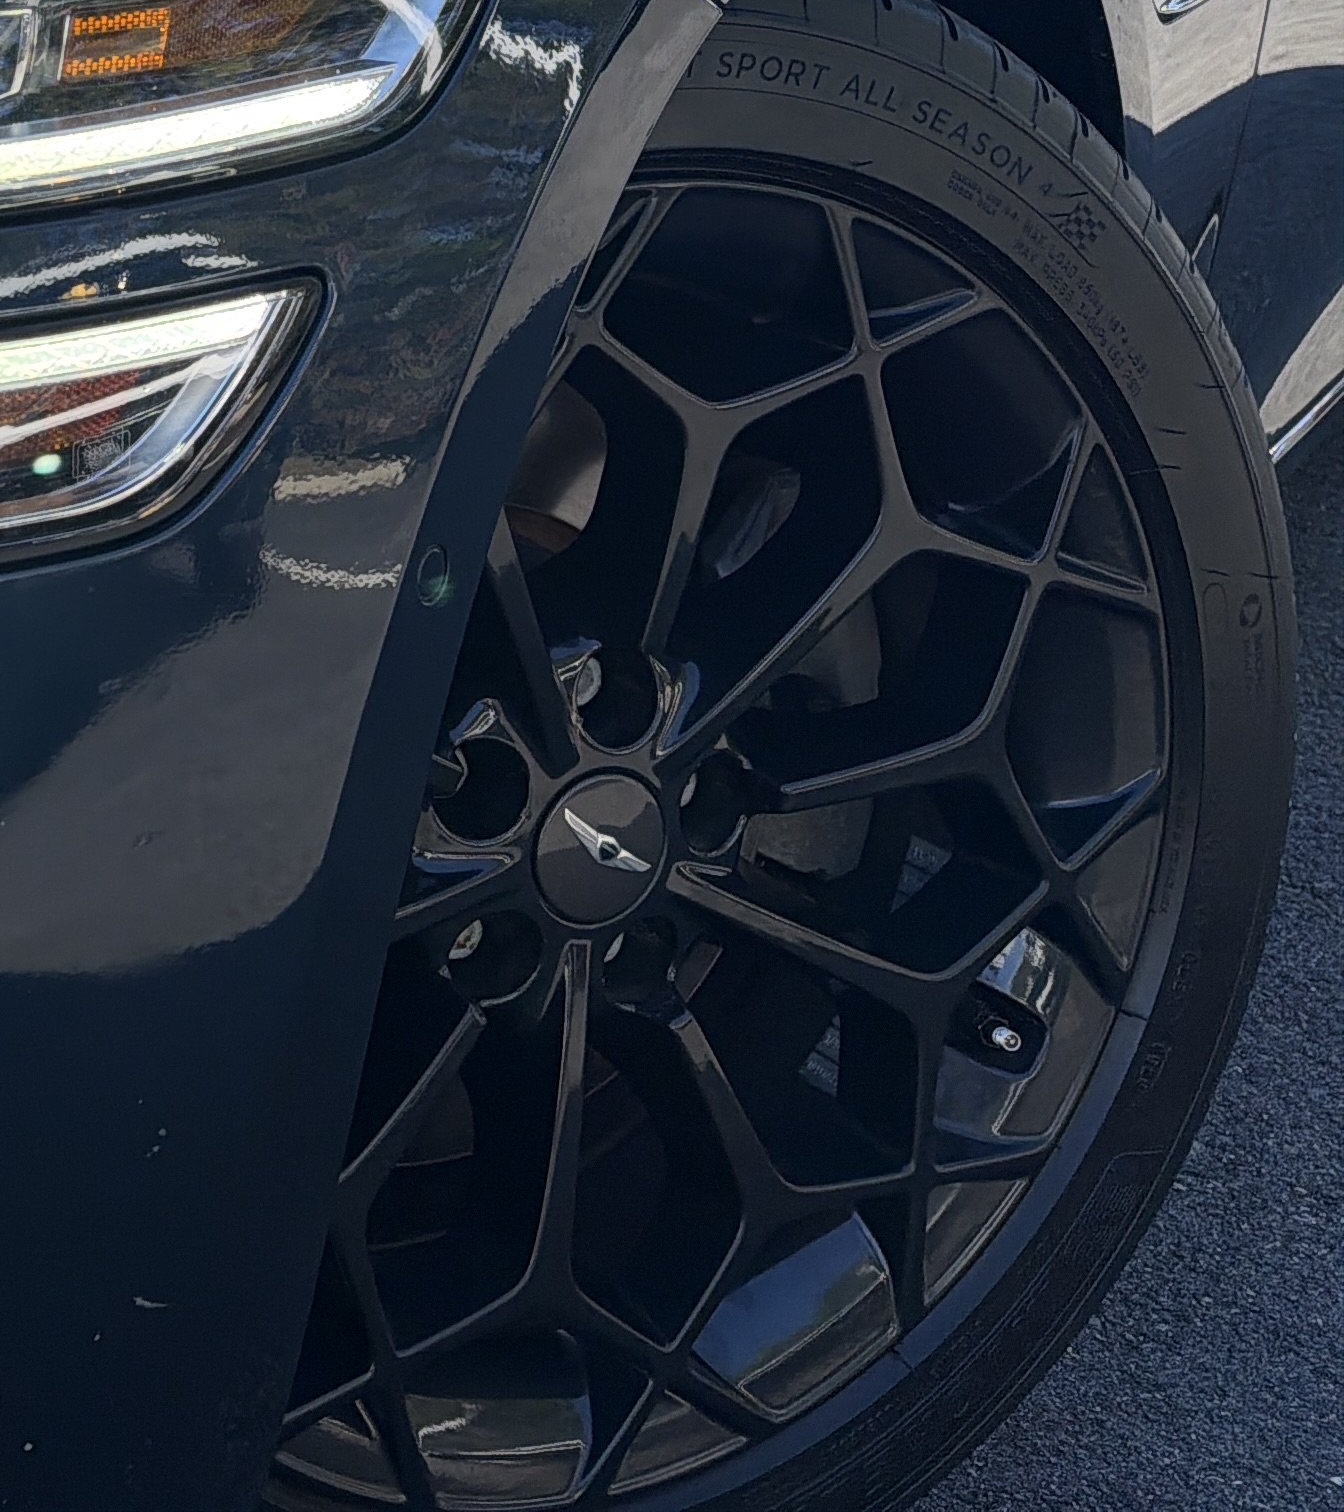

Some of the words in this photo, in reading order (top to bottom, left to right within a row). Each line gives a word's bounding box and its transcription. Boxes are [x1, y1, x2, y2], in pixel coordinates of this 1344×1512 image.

[716, 51, 831, 90] SPORT
[839, 74, 898, 113] ALL
[912, 100, 1033, 186] SEASON
